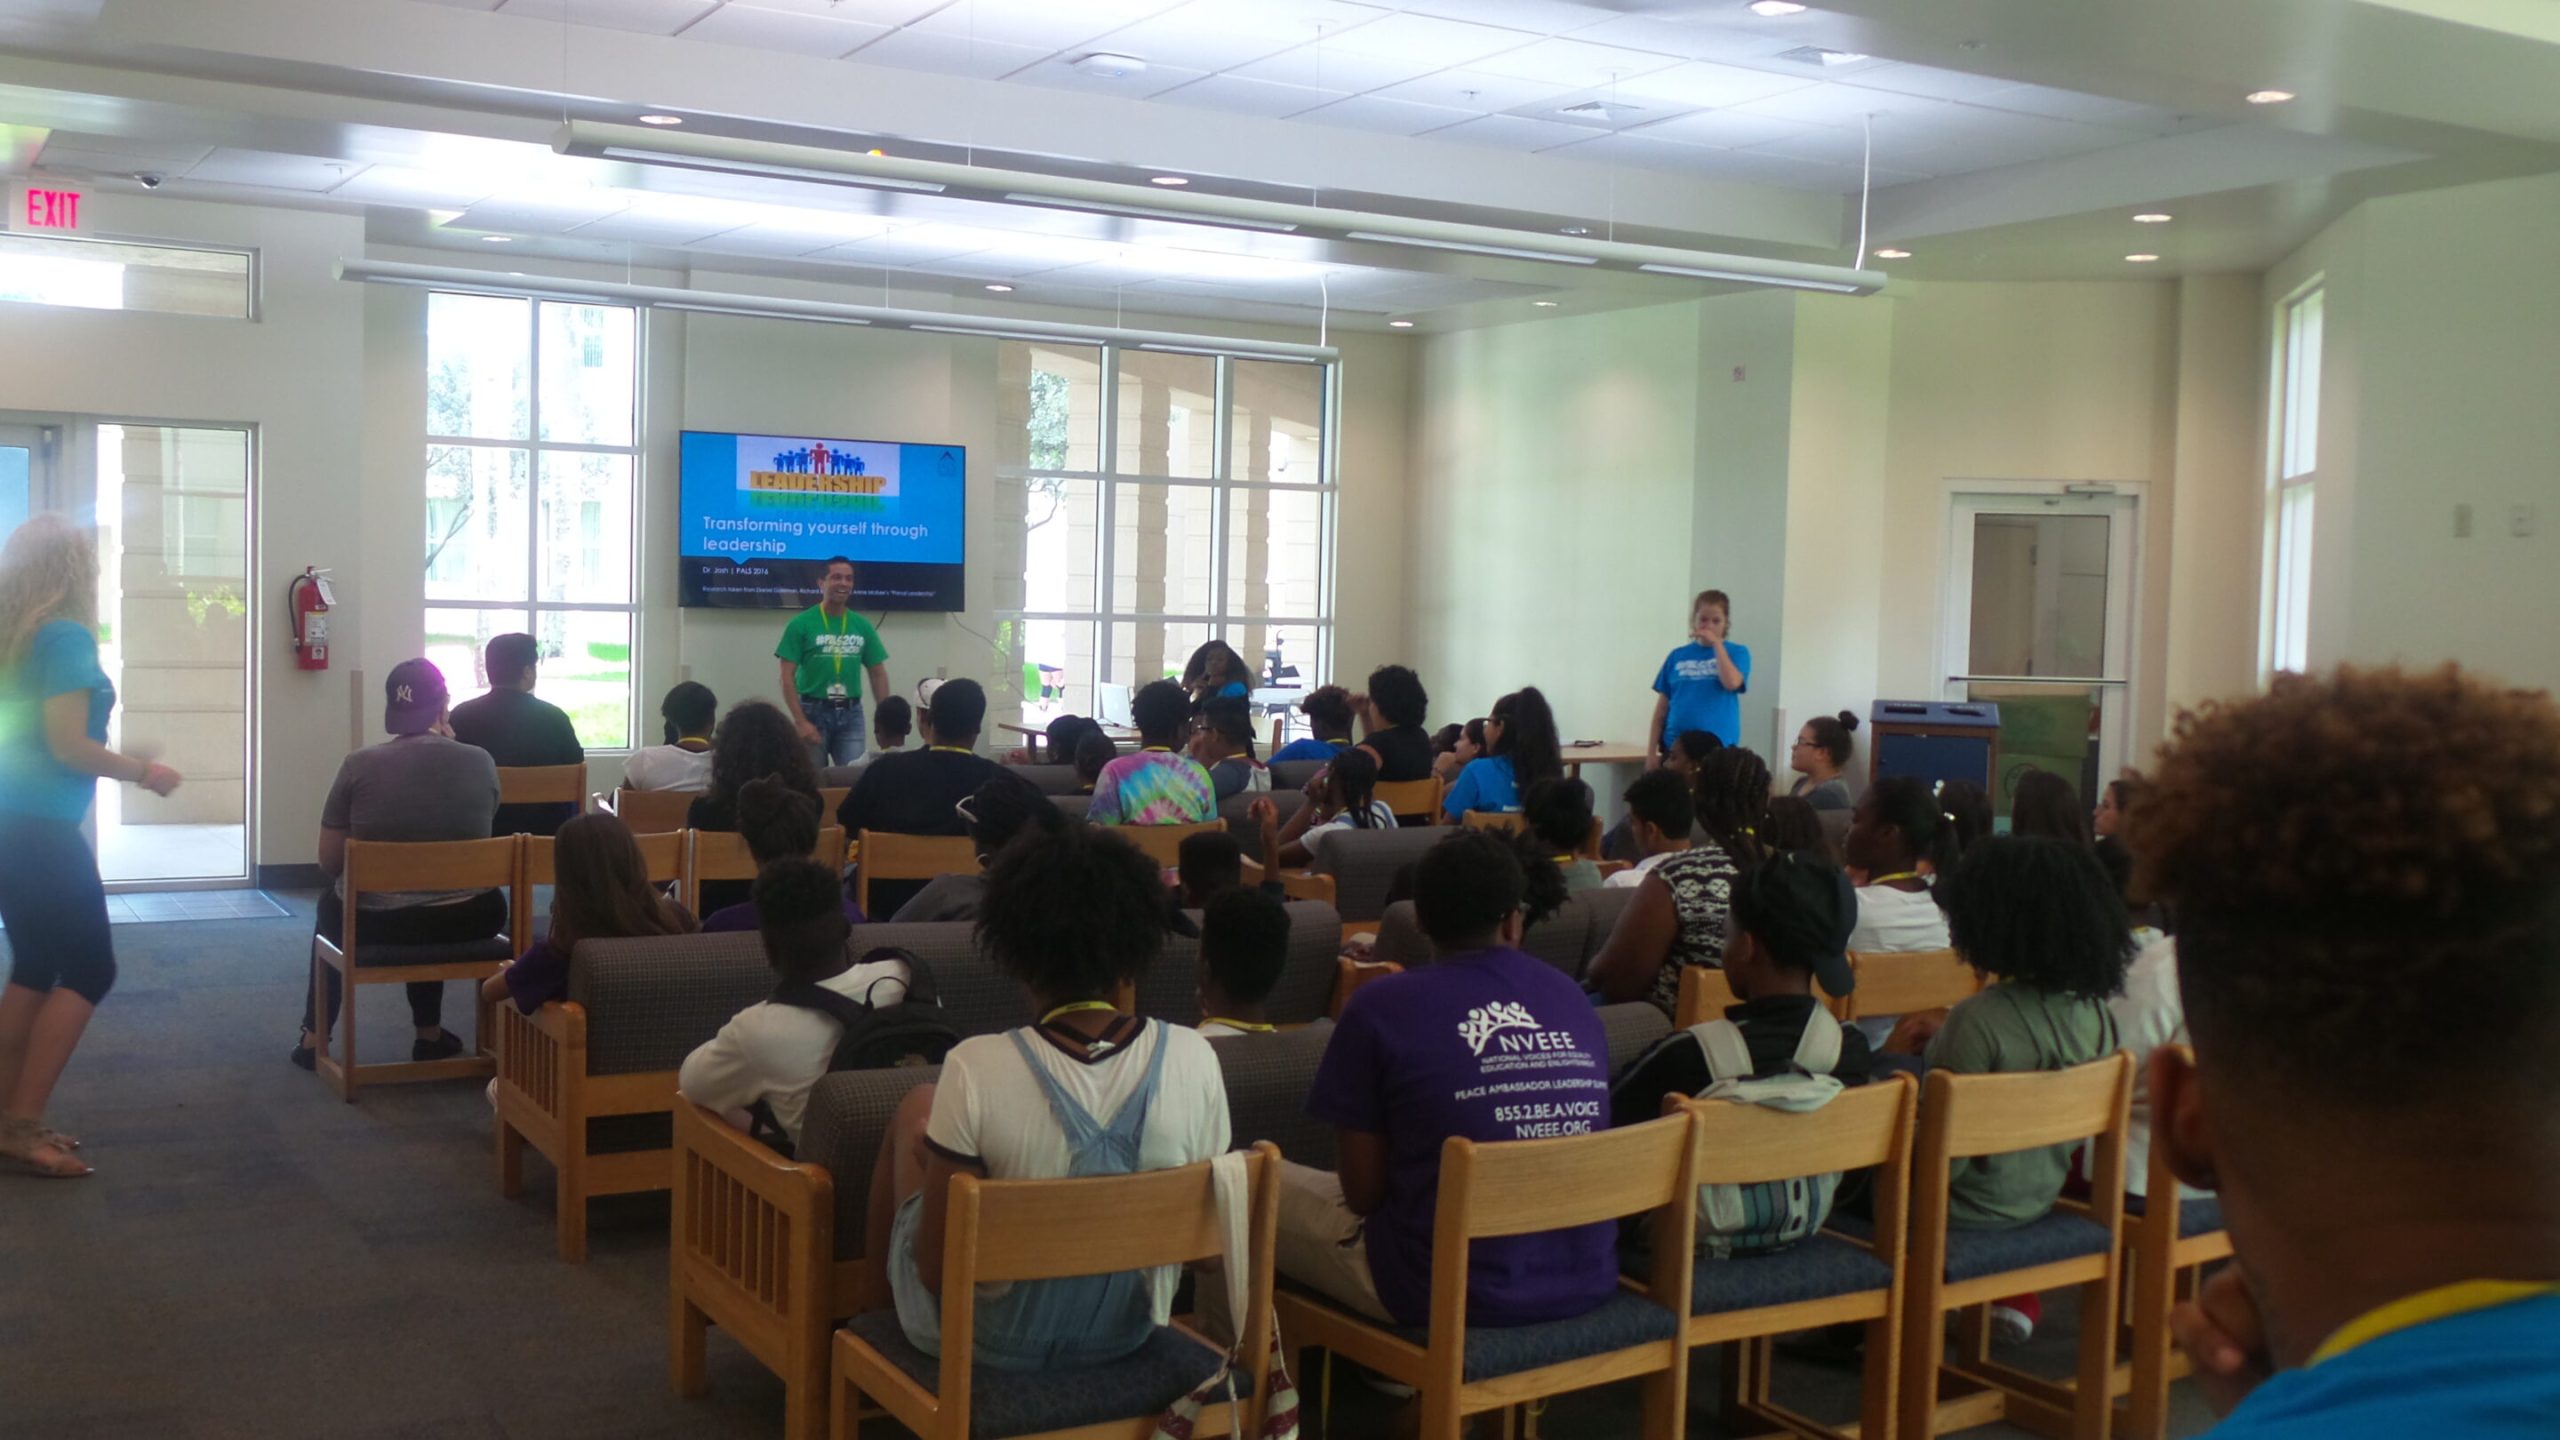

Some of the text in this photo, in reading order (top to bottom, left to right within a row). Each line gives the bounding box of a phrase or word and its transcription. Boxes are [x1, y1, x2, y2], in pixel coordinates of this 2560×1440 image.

[27, 189, 81, 229] EXIT
[751, 471, 887, 494] LEADERSHIP
[703, 516, 928, 540] Transforming yourself through
[703, 537, 786, 555] leadership
[1499, 1032, 1575, 1052] NVEEE
[1480, 1061, 1529, 1074] EDUCATION
[1529, 1060, 1546, 1069] AND
[1481, 1054, 1521, 1064] NATIONAL
[1523, 1052, 1551, 1061] VOICES
[1454, 1086, 1486, 1101] PEACE
[1488, 1079, 1551, 1095] AMBASSADOR
[1552, 1078, 1592, 1090] LEADERSHIP
[1515, 1120, 1591, 1139] NVEEE.ORG
